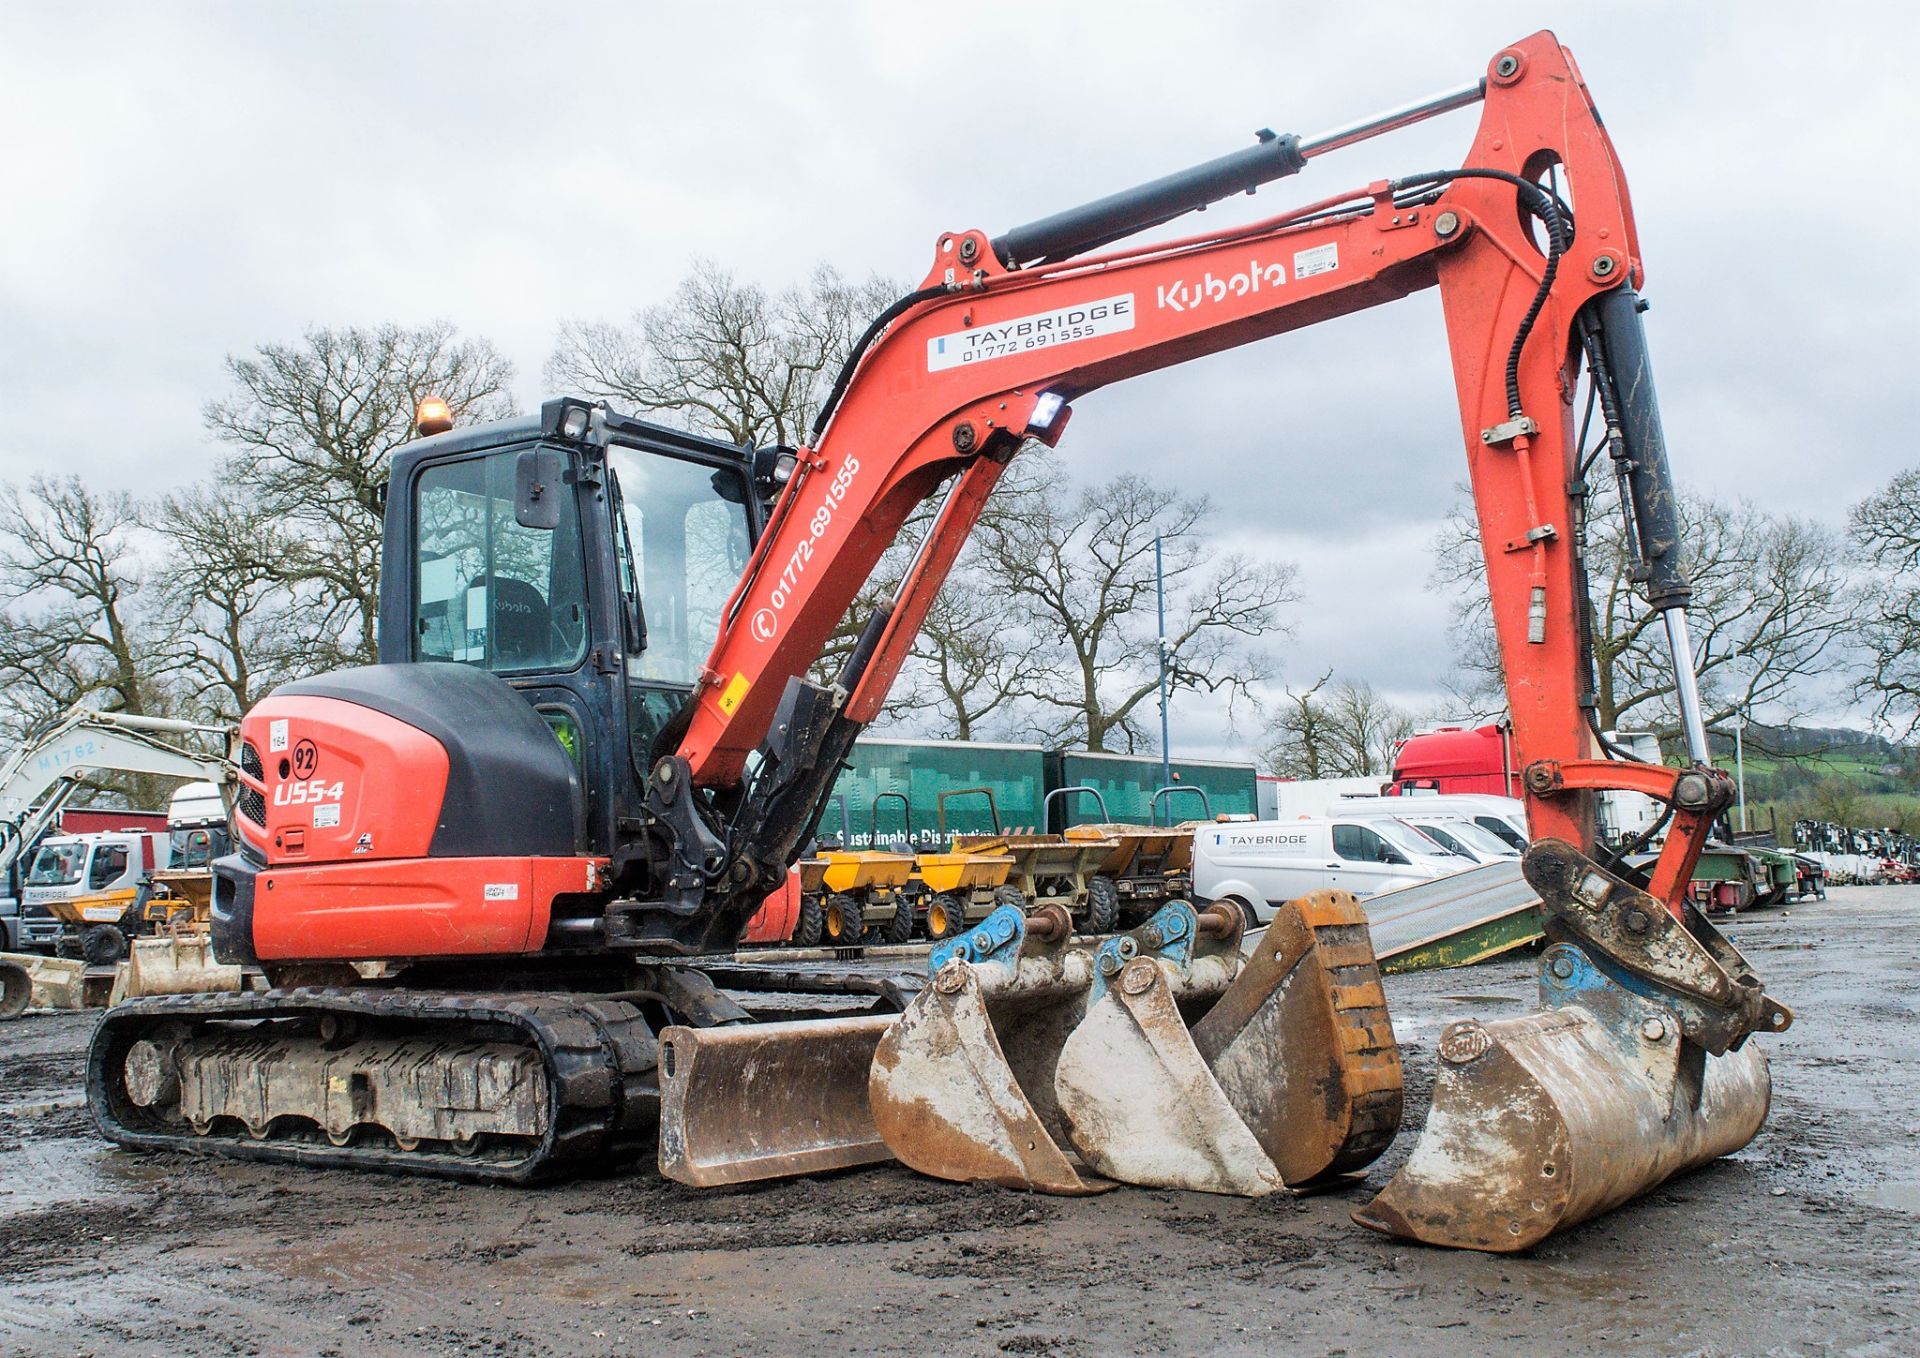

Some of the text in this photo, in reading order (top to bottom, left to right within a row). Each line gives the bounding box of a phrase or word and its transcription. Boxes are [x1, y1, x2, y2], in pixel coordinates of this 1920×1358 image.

[1157, 260, 1287, 312] Kubota
[966, 301, 1129, 347] TAYBRIDGE
[963, 325, 1095, 362] 01772 691555
[771, 453, 860, 610] 01772-691555
[295, 747, 314, 770] 92
[273, 780, 344, 806] U55-4
[1230, 835, 1307, 845] TAYBRIDGE
